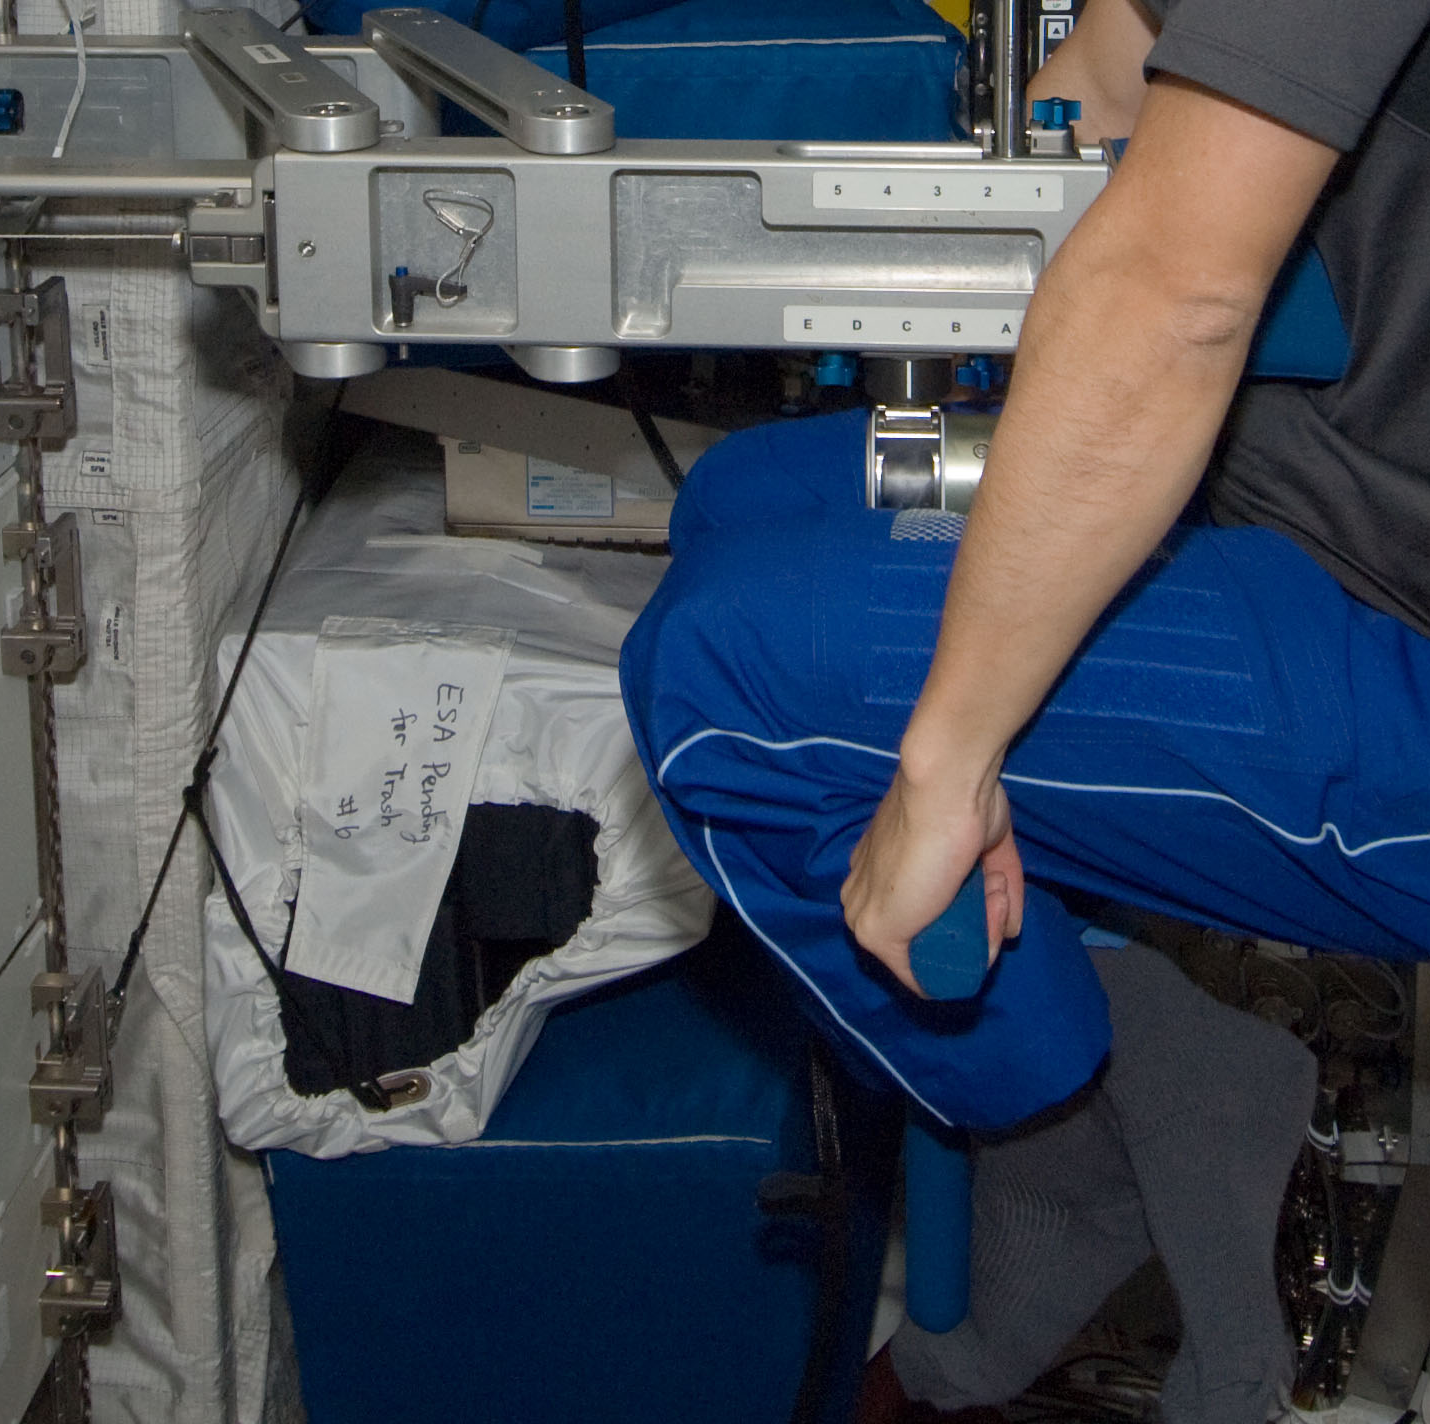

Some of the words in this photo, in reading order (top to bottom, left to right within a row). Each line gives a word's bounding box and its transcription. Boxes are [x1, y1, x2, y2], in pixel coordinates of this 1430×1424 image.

[834, 184, 842, 196] 5
[883, 185, 892, 196] 4
[934, 186, 942, 197] 3
[984, 186, 992, 198] 2
[1036, 187, 1042, 198] 1
[804, 318, 812, 330] E
[852, 319, 862, 331] D
[902, 320, 912, 332] C
[952, 322, 961, 333] B
[1001, 323, 1012, 335] A
[380, 762, 408, 828] Trash
[399, 761, 452, 846] Pending
